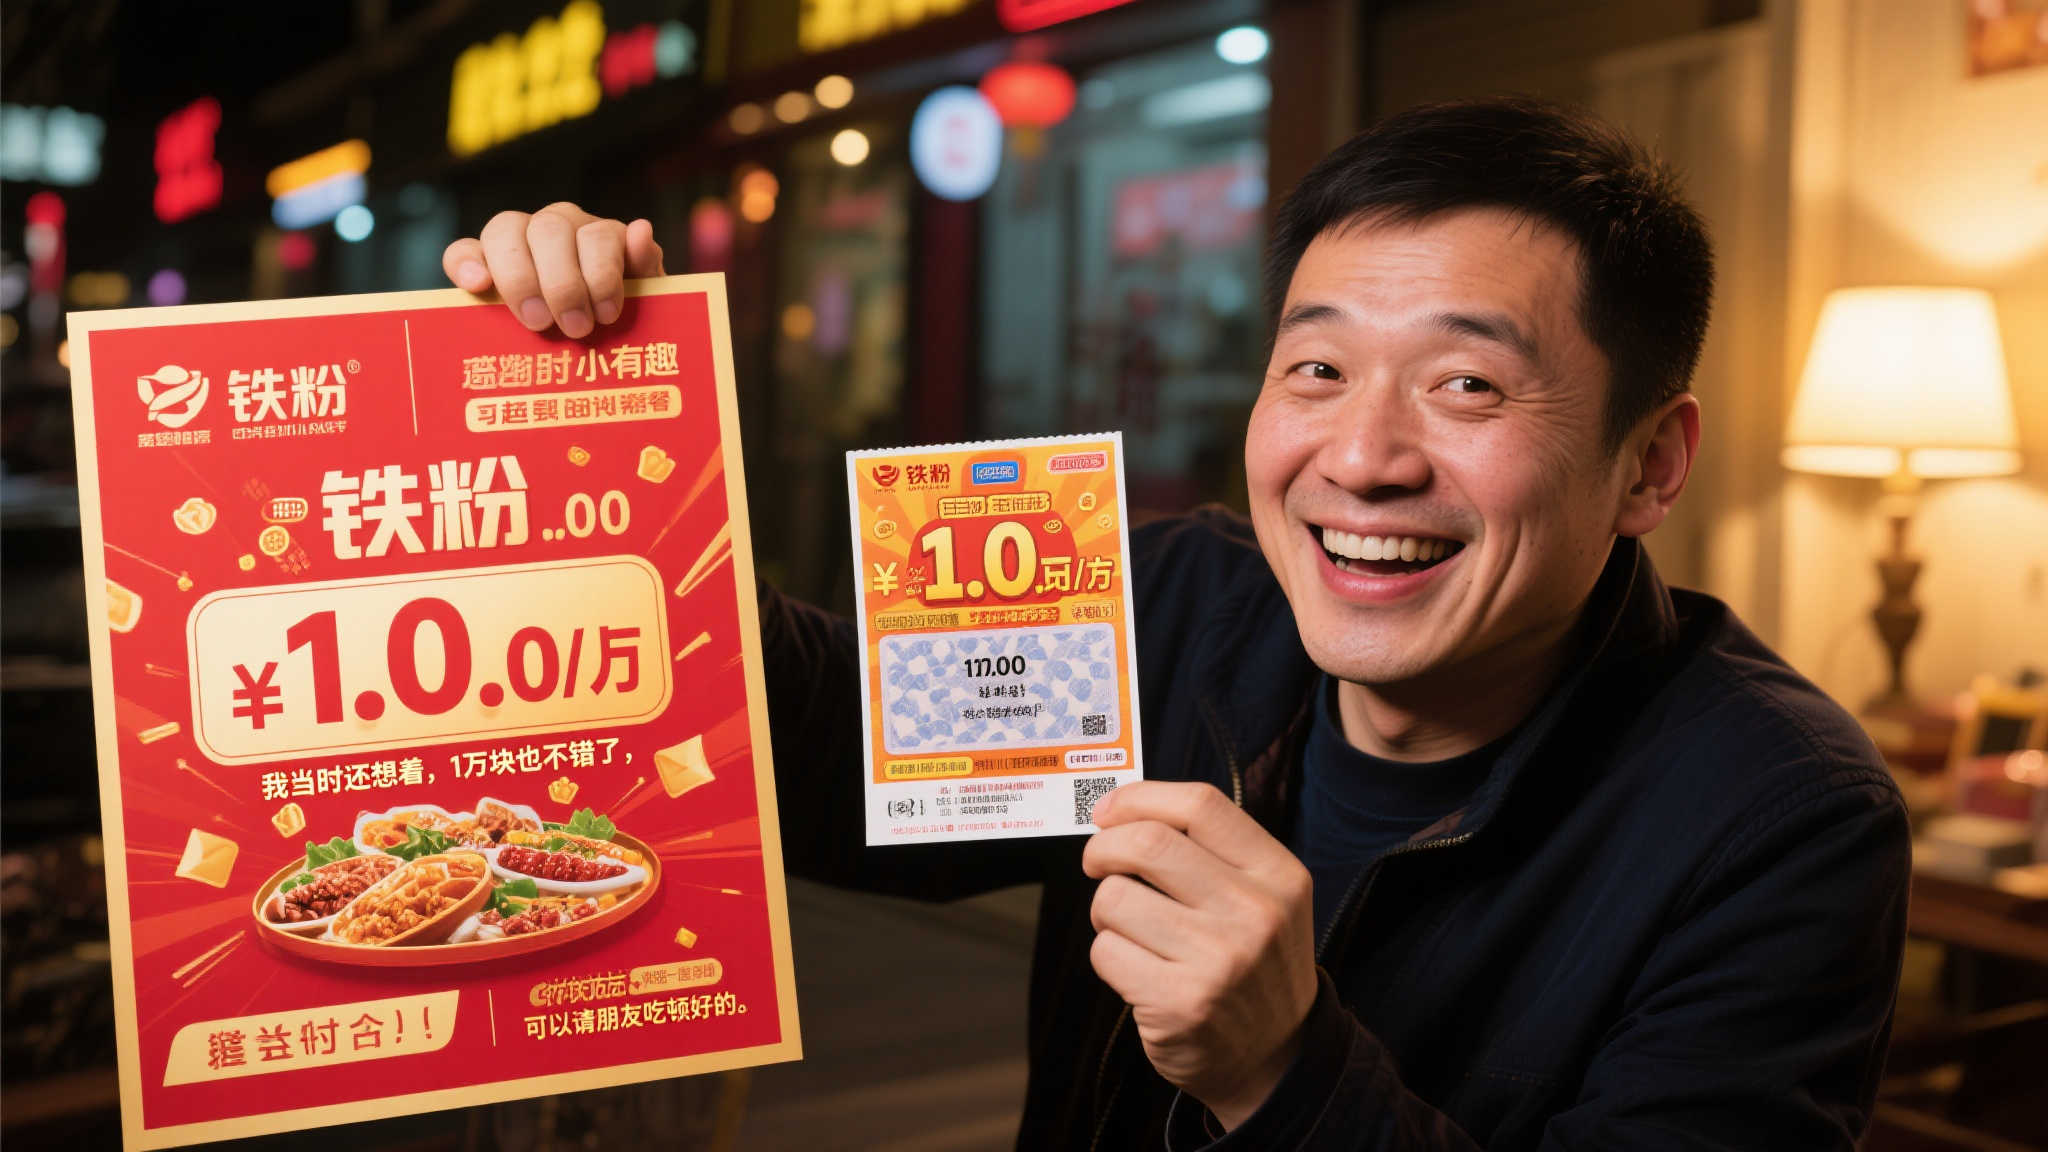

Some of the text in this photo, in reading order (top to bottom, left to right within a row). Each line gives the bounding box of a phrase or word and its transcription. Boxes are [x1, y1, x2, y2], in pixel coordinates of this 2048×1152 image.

[227, 364, 347, 423] 铁粉
[906, 463, 951, 485] 铁粉
[320, 455, 530, 560] 铁粉
[261, 737, 634, 800] 我当时还想着，1万块也不错了，
[523, 991, 749, 1040] 可以请朋友吃顿好的。
